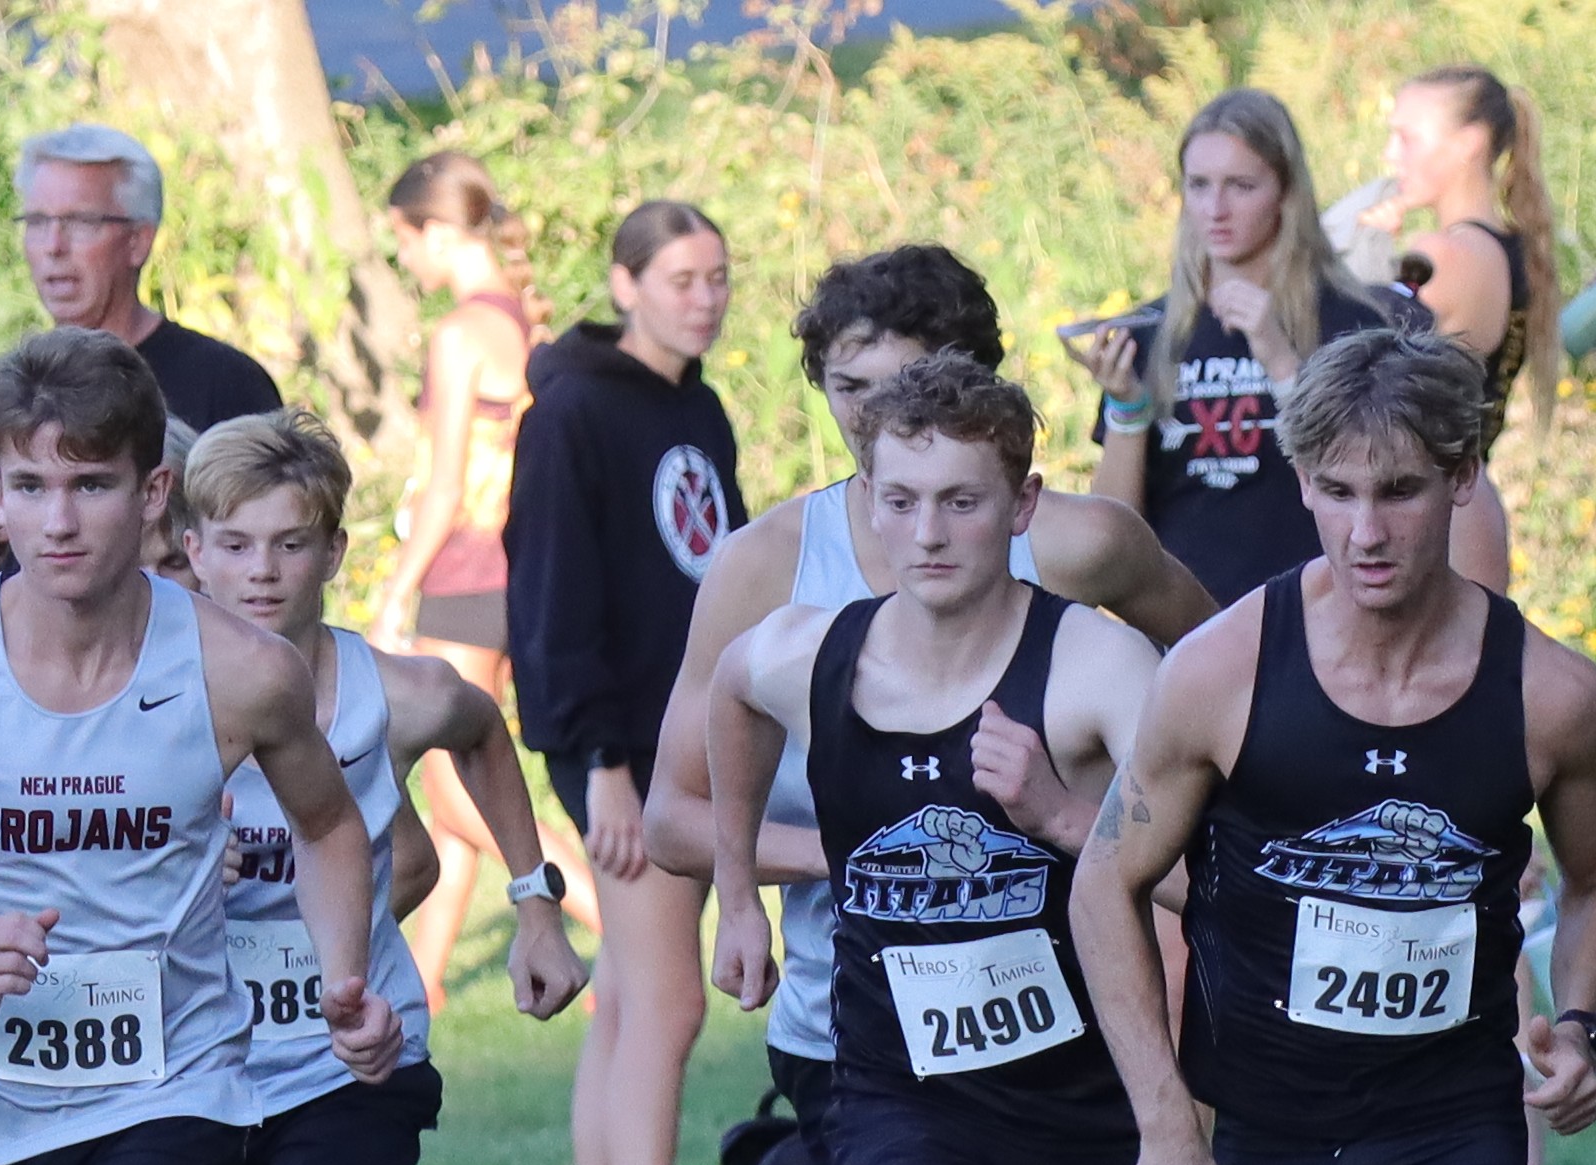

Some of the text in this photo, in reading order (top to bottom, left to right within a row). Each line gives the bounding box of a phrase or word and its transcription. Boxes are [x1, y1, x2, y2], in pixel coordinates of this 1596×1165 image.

[21, 775, 125, 796] NEW PRAGUE
[843, 864, 1048, 923] TITANS
[278, 947, 316, 969] TIMI
[1402, 939, 1460, 962] TIMING
[980, 961, 1045, 987] TIMING
[81, 982, 145, 1007] TIMING
[1314, 965, 1451, 1019] 2492
[923, 985, 1056, 1057] 2490
[5, 1013, 142, 1071] 2388
